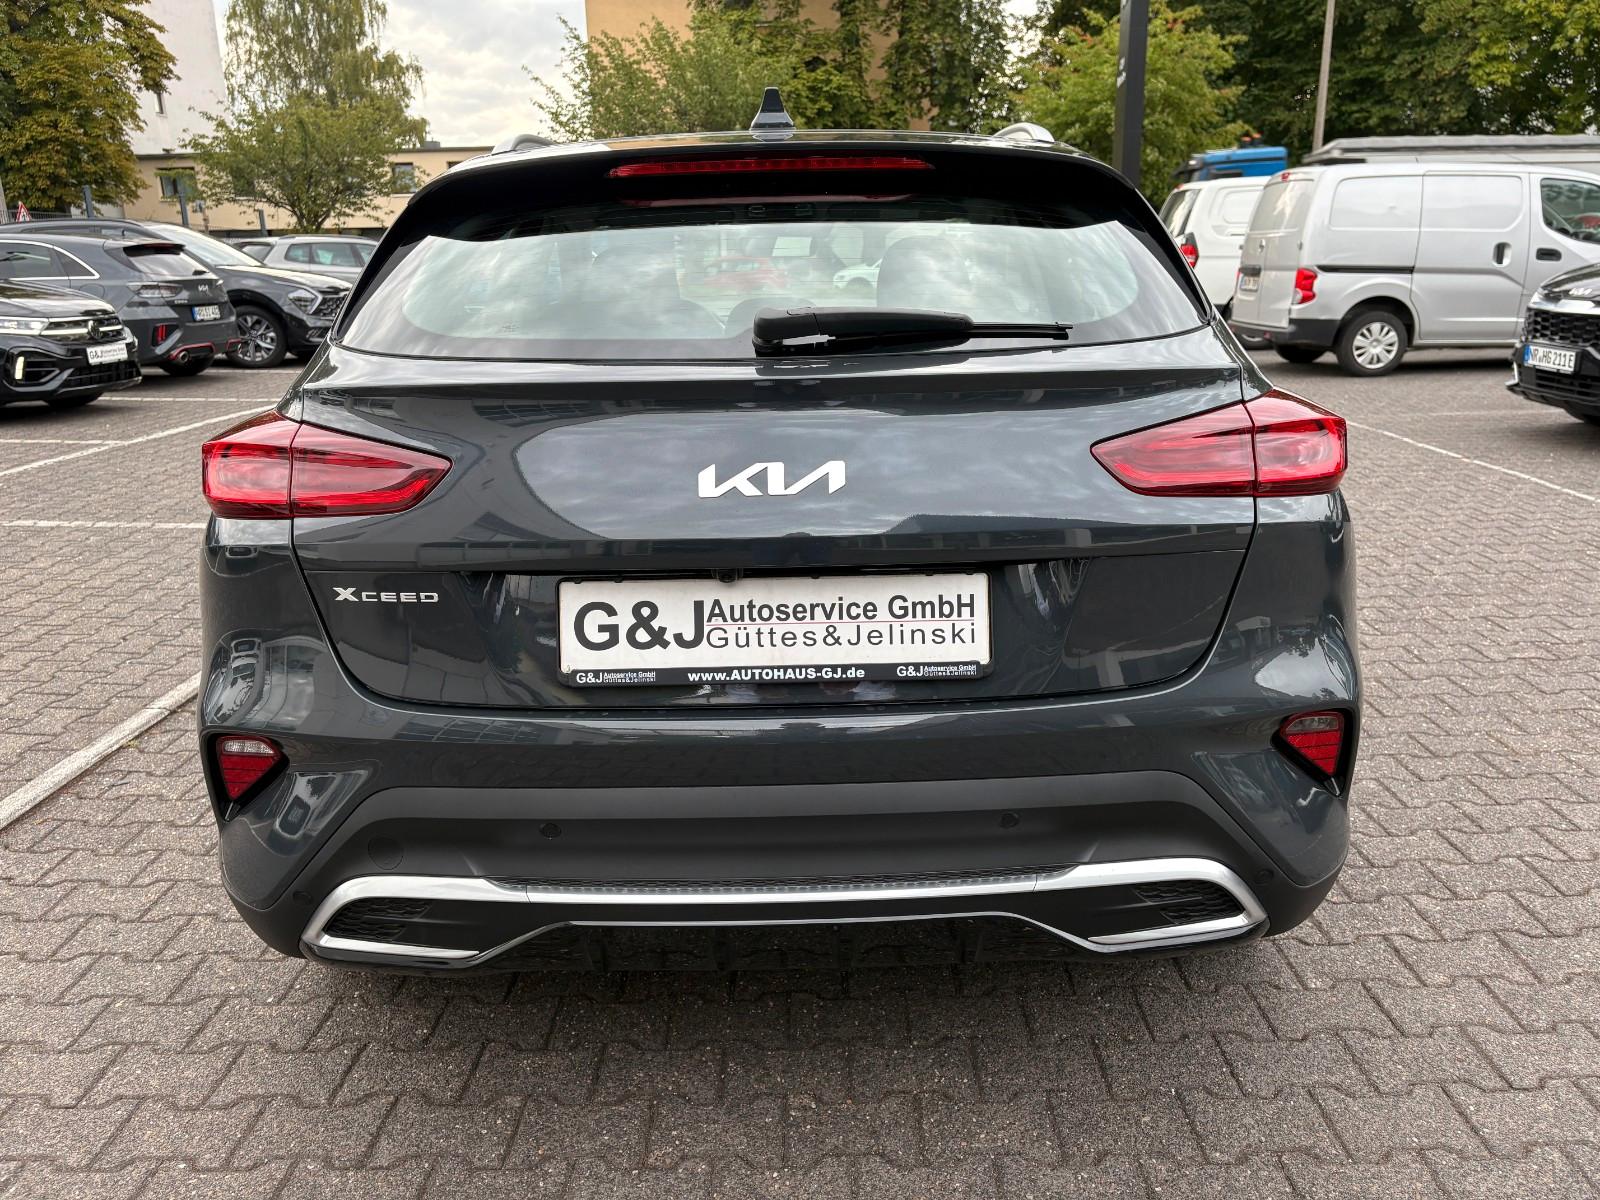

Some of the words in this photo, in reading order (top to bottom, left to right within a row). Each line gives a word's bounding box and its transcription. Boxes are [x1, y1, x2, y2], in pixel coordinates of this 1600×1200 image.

[698, 460, 846, 498] KIA
[706, 596, 878, 623] Autoservice
[888, 593, 975, 619] GmbH
[573, 600, 705, 651] G&J
[706, 622, 976, 649] Güttes&Jelinski
[576, 672, 603, 683] G&J
[687, 667, 865, 682] www.AUTOHAUS-GJ.de
[896, 665, 924, 677] G&J
